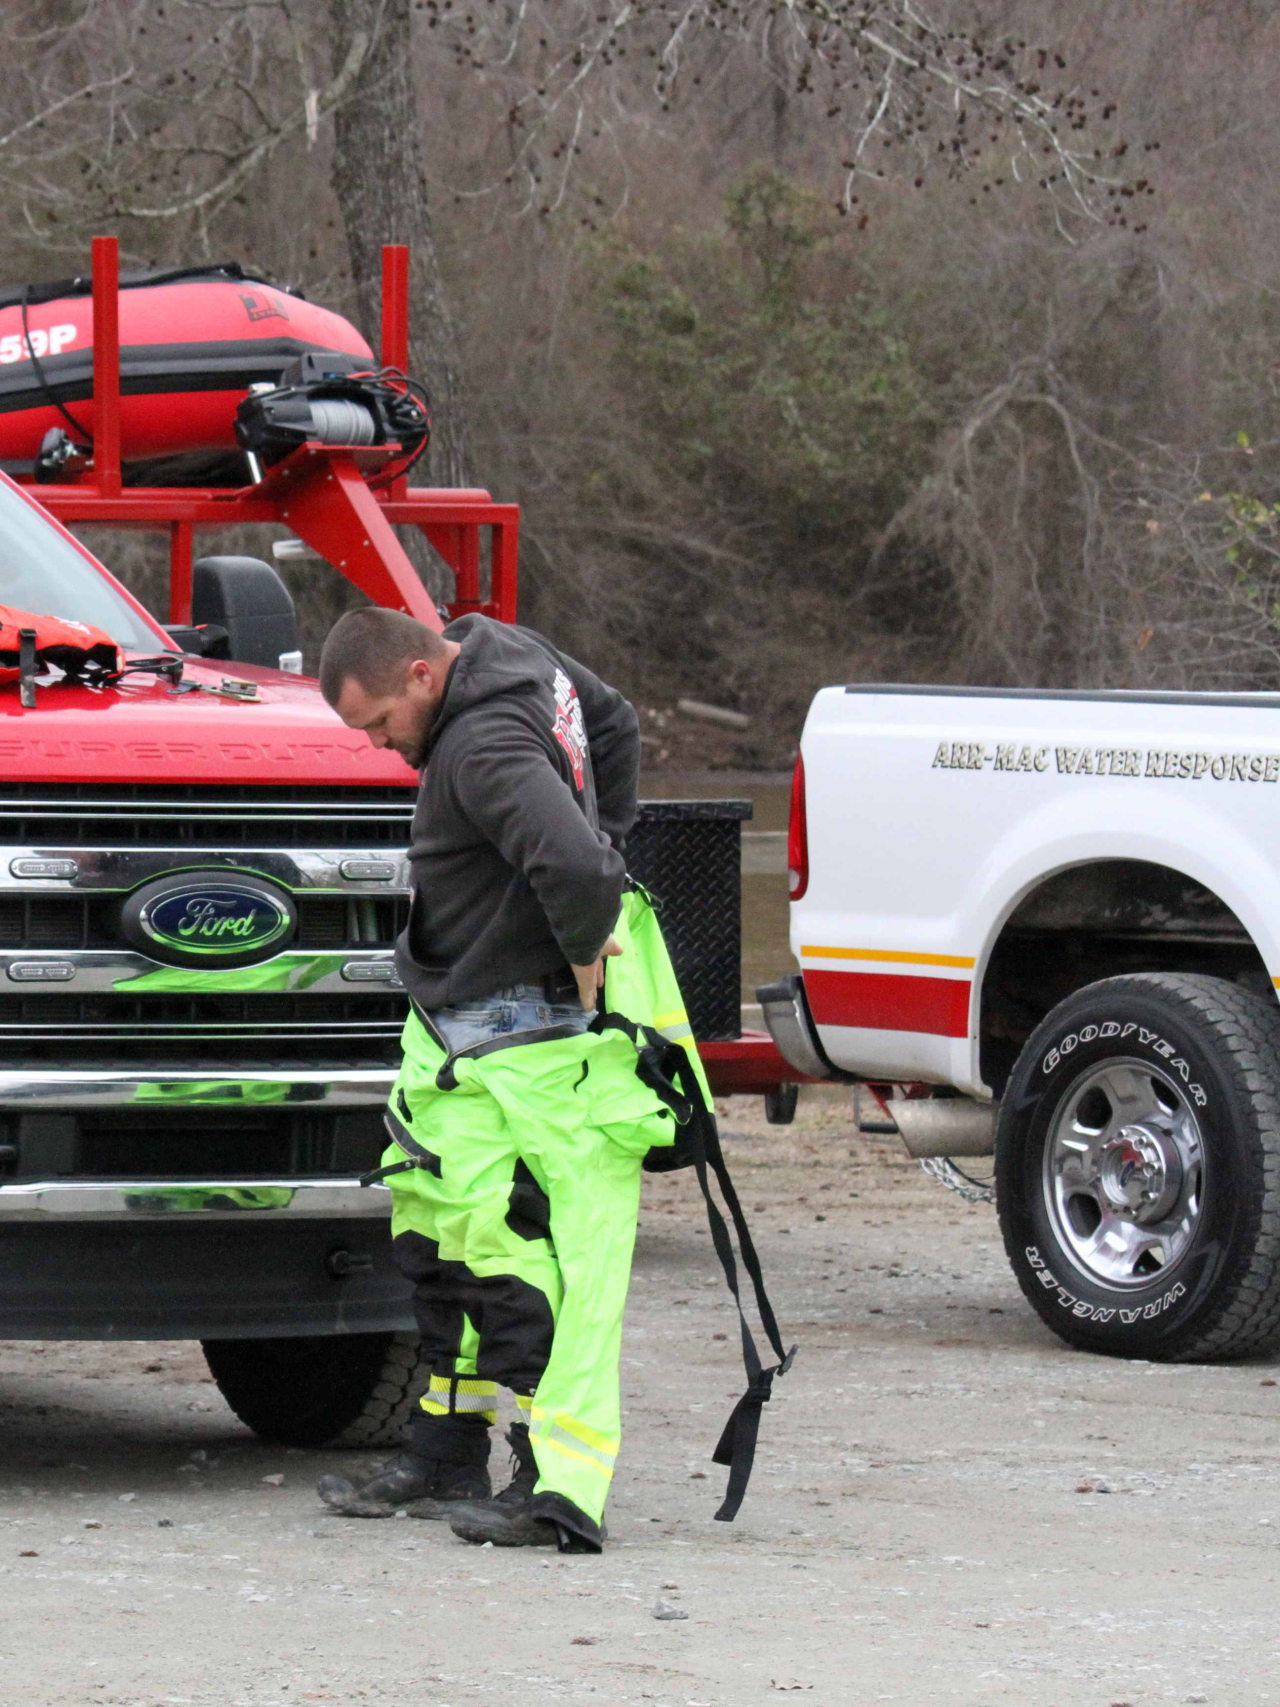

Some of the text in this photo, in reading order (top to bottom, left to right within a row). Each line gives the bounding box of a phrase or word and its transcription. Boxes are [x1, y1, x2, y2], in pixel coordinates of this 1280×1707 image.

[218, 742, 369, 763] DUTY
[932, 741, 1280, 783] ARR-MAC WATER RESPONSE
[178, 898, 257, 936] Ford
[1042, 1021, 1207, 1106] GOODYEAR
[1025, 1246, 1186, 1324] WRANGLER
